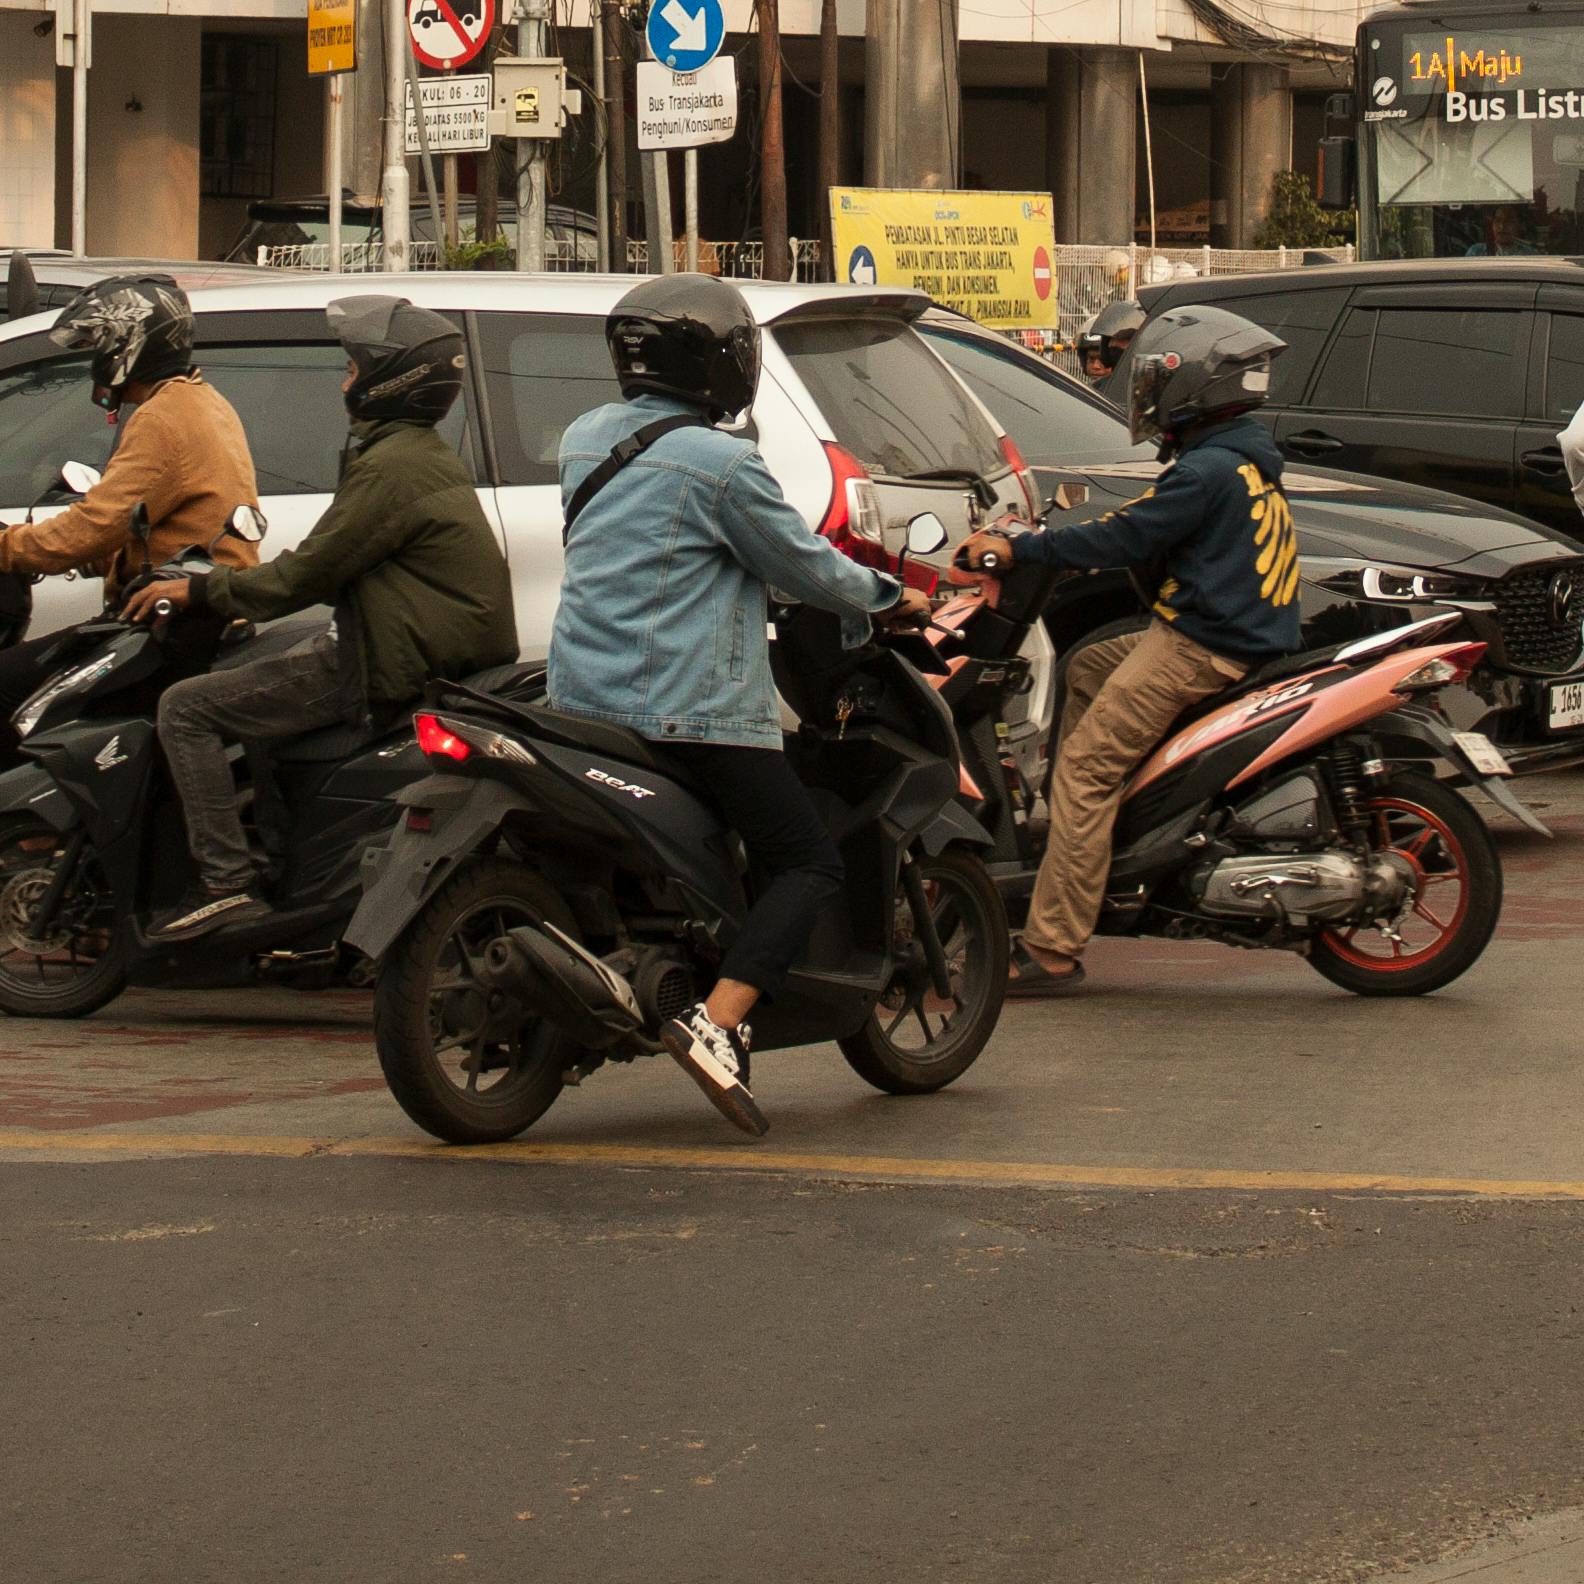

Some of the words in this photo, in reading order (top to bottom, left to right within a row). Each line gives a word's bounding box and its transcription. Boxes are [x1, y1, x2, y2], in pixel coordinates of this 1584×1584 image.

[1409, 50, 1446, 80] 1A
[1460, 48, 1523, 84] Maju
[450, 87, 462, 99] 06
[474, 85, 486, 98] 20
[649, 96, 665, 112] Bus
[669, 91, 724, 114] Transjakarta
[1446, 89, 1507, 123] Bus
[425, 114, 451, 126] DIATAS
[454, 112, 472, 125] 5500
[474, 111, 485, 123] KG
[642, 115, 733, 139] Penghuni/Konsumen
[408, 131, 440, 144] KEALI
[442, 130, 460, 142] HARI
[462, 129, 484, 141] LIBUR
[885, 224, 933, 245] PEMBATASAN
[944, 226, 966, 245] PINTU
[966, 226, 988, 246] BESAR
[989, 226, 1020, 246] SELATAN
[896, 250, 920, 270] HANYA
[920, 250, 944, 270] UNTUK
[945, 250, 959, 270] BUS
[959, 251, 982, 270] TRANS
[947, 276, 961, 295] DAN
